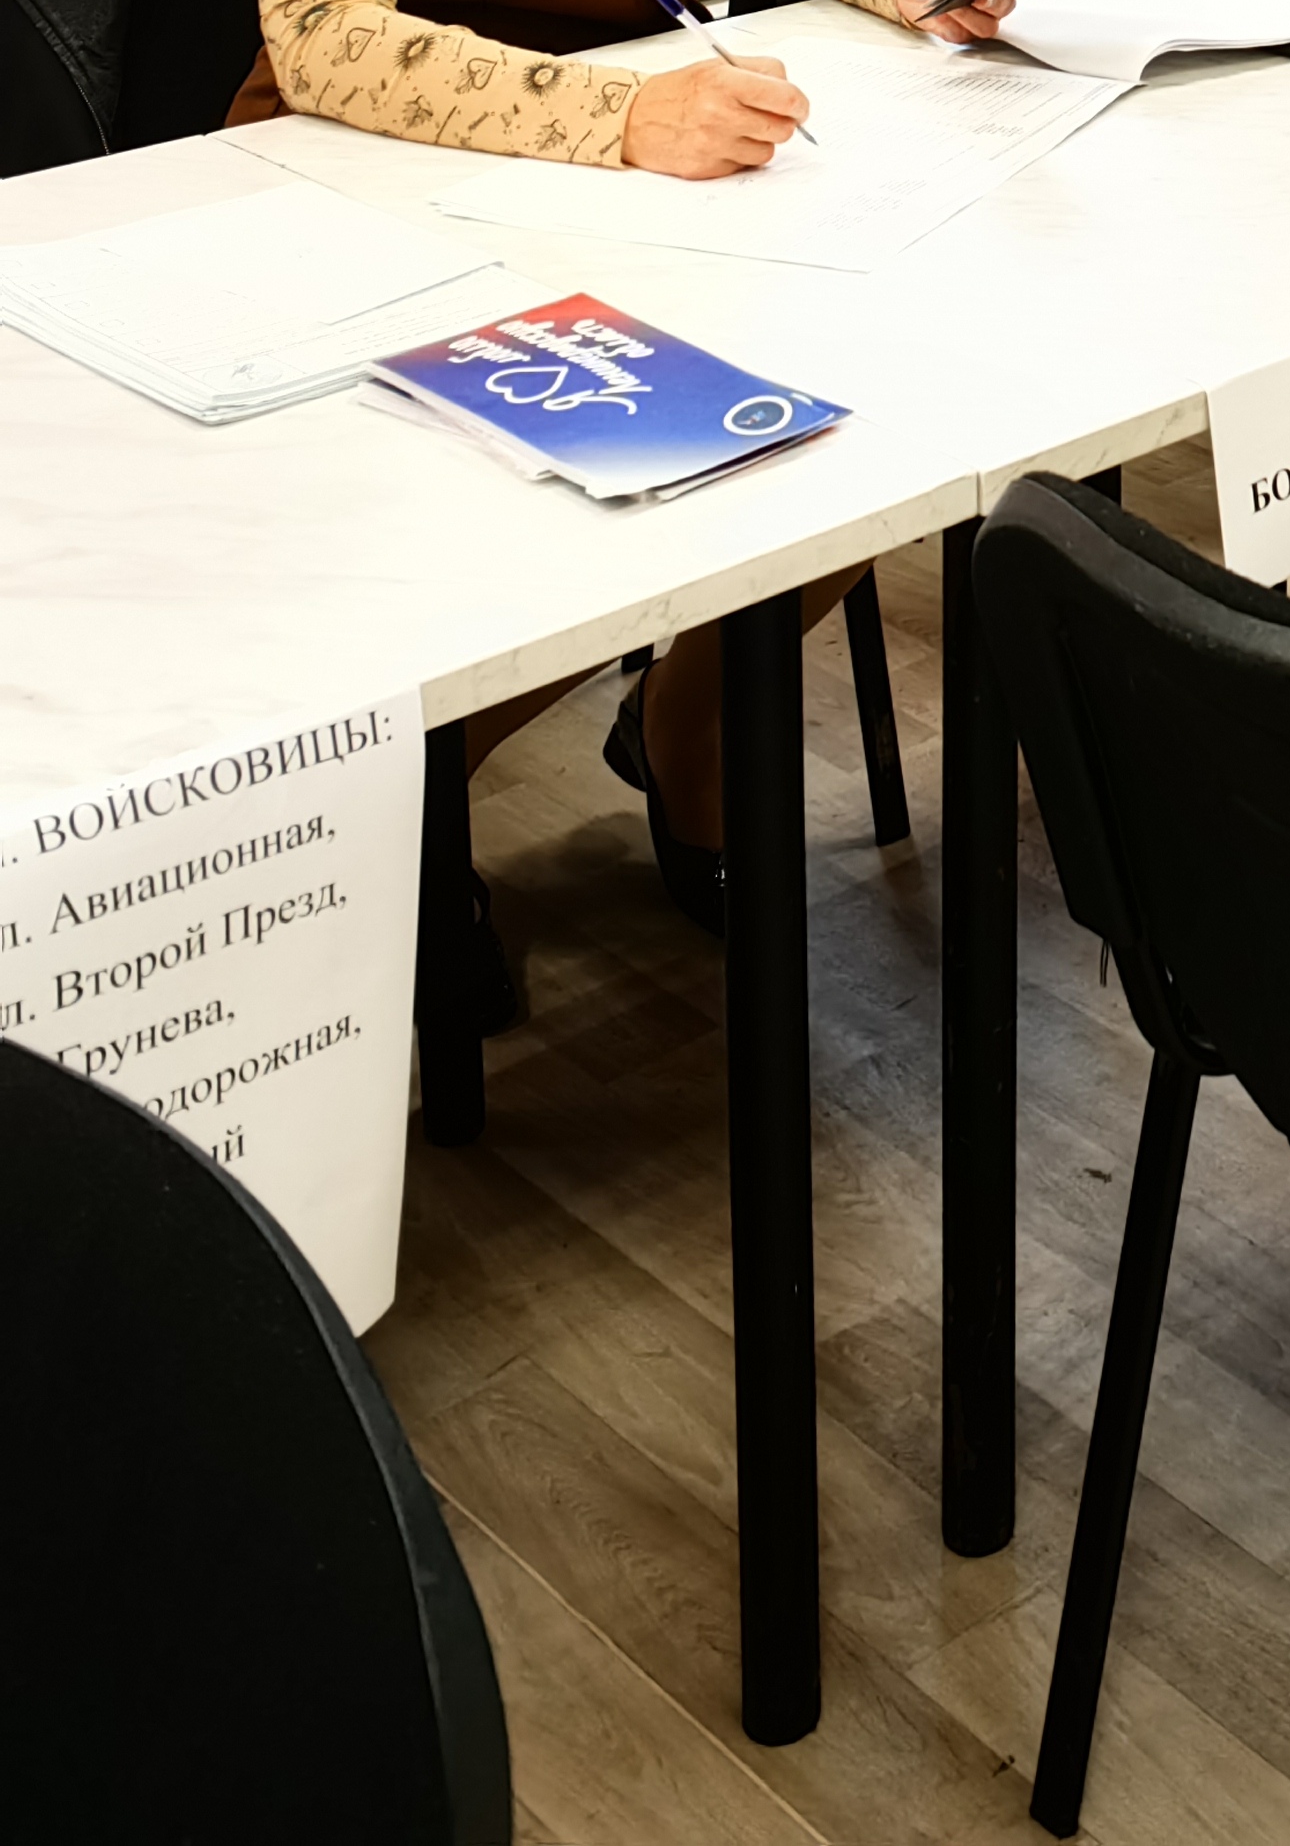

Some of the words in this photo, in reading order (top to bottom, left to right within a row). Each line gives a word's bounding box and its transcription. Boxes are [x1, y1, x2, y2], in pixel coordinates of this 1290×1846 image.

[32, 709, 394, 855] ВОЙСКОВИЦЫ:
[49, 812, 336, 935] Авиационная,
[53, 924, 207, 1012] Второй
[221, 878, 348, 950] Презд,
